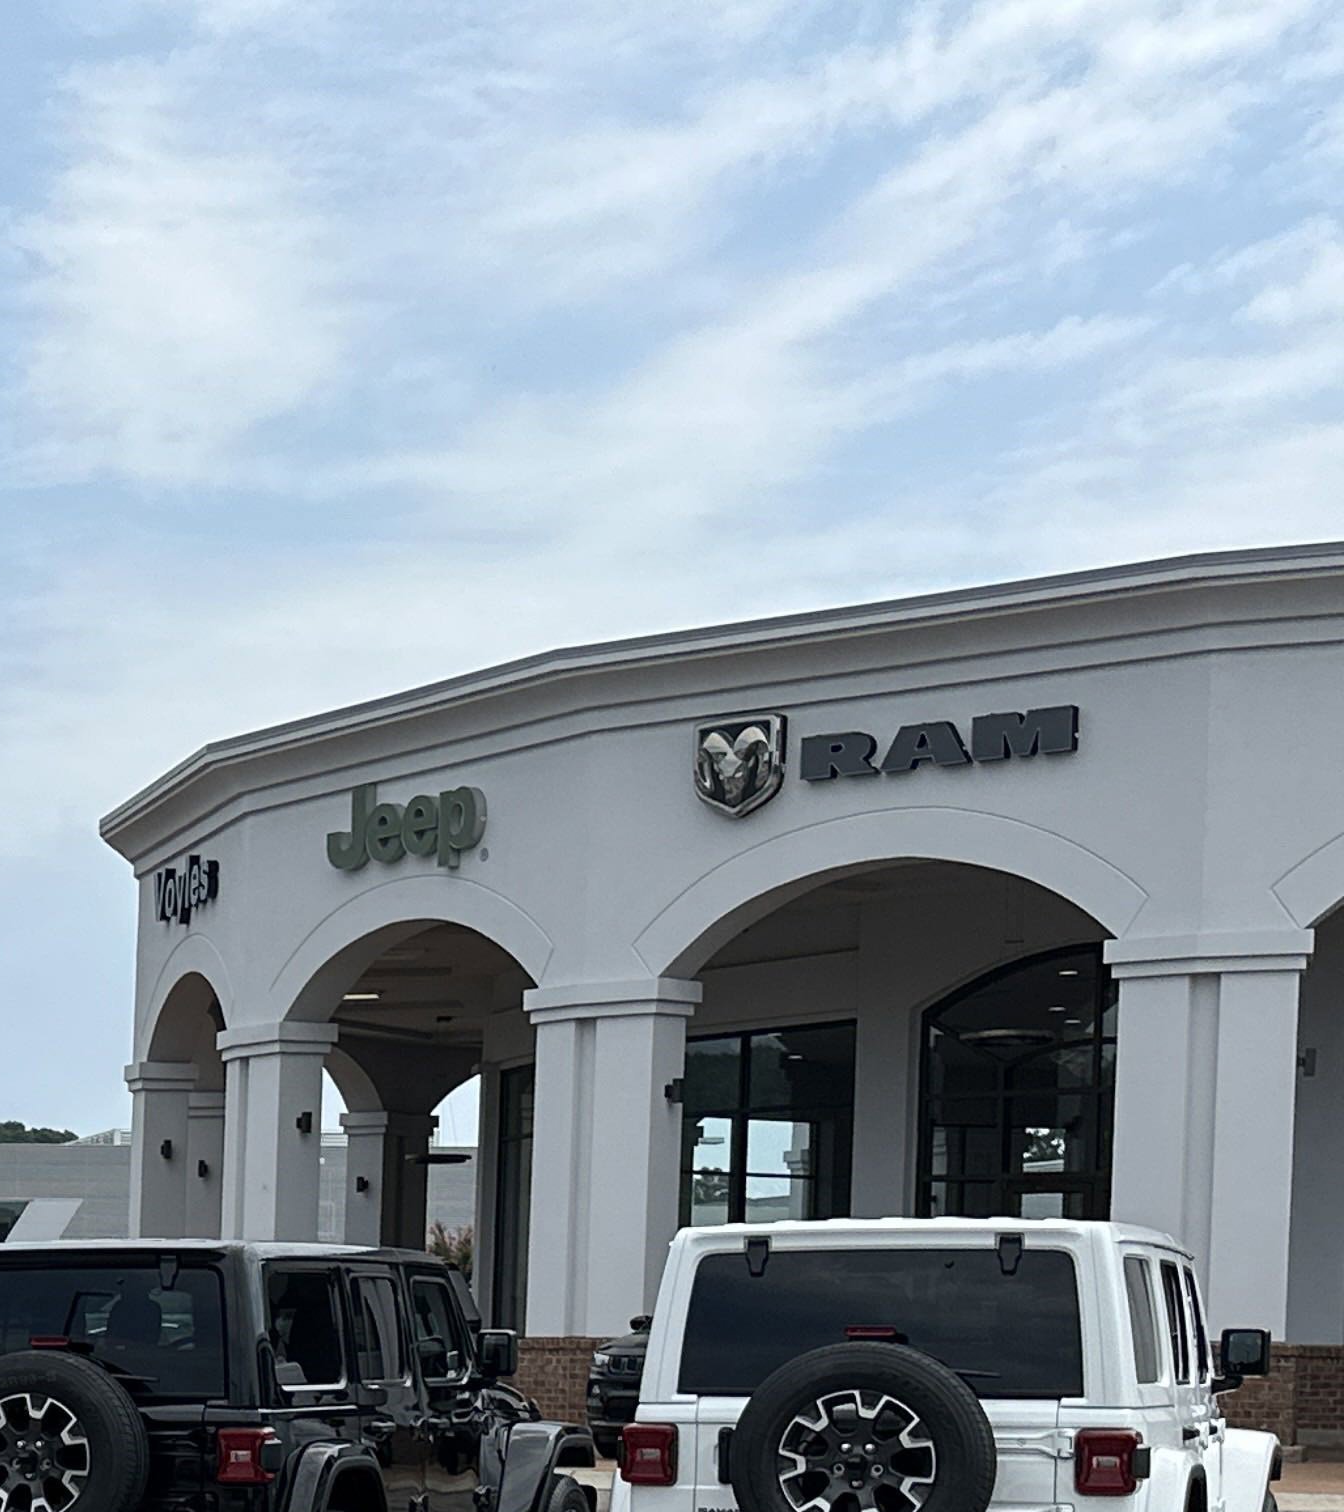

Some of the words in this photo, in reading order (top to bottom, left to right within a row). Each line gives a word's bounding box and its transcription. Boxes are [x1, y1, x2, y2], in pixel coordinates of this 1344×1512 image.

[800, 704, 1080, 781] RAM
[326, 783, 487, 871] Jeep
[153, 854, 219, 926] Voyles
